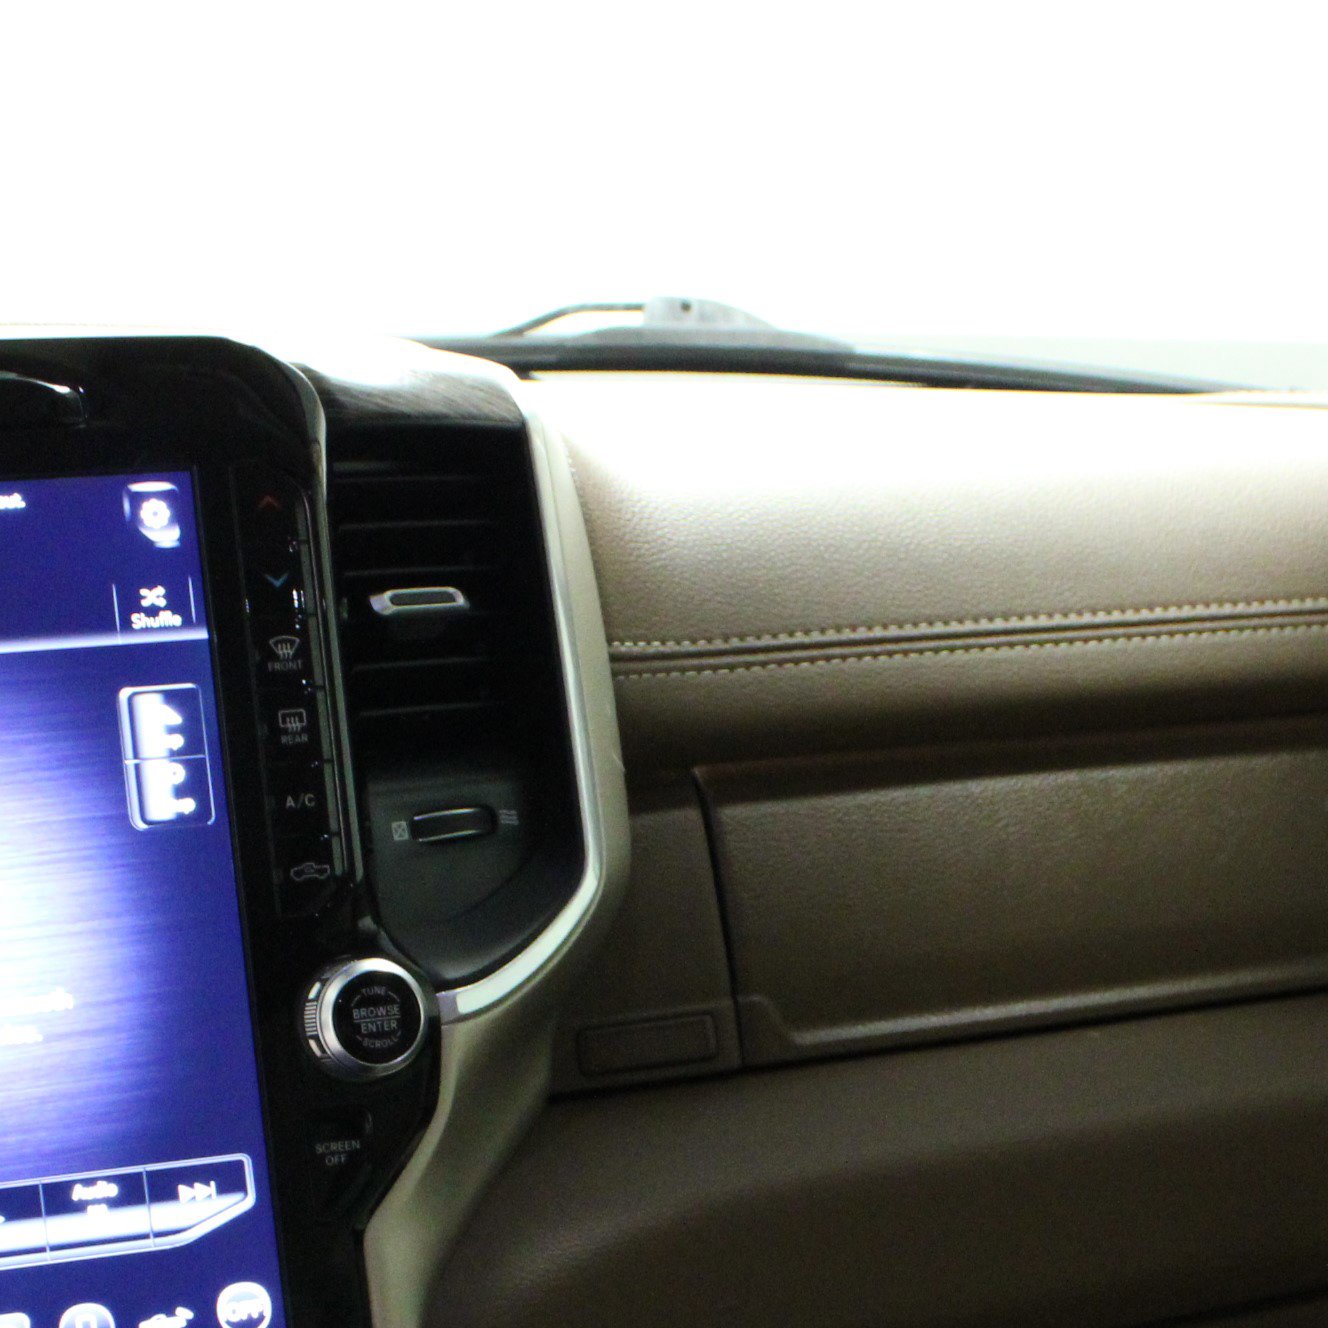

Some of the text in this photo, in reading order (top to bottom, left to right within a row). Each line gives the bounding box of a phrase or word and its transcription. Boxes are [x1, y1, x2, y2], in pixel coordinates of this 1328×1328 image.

[130, 609, 183, 630] Shuffle
[267, 659, 303, 673] FRONT
[280, 733, 309, 745] REAR
[285, 793, 316, 810] A/C
[361, 985, 388, 997] TUNE
[352, 1004, 401, 1019] BROWSE
[360, 1019, 398, 1034] ENTER
[362, 1037, 399, 1049] SCROLL
[315, 1139, 361, 1154] SCREEN
[325, 1154, 348, 1167] OFF
[72, 1180, 118, 1202] Audio
